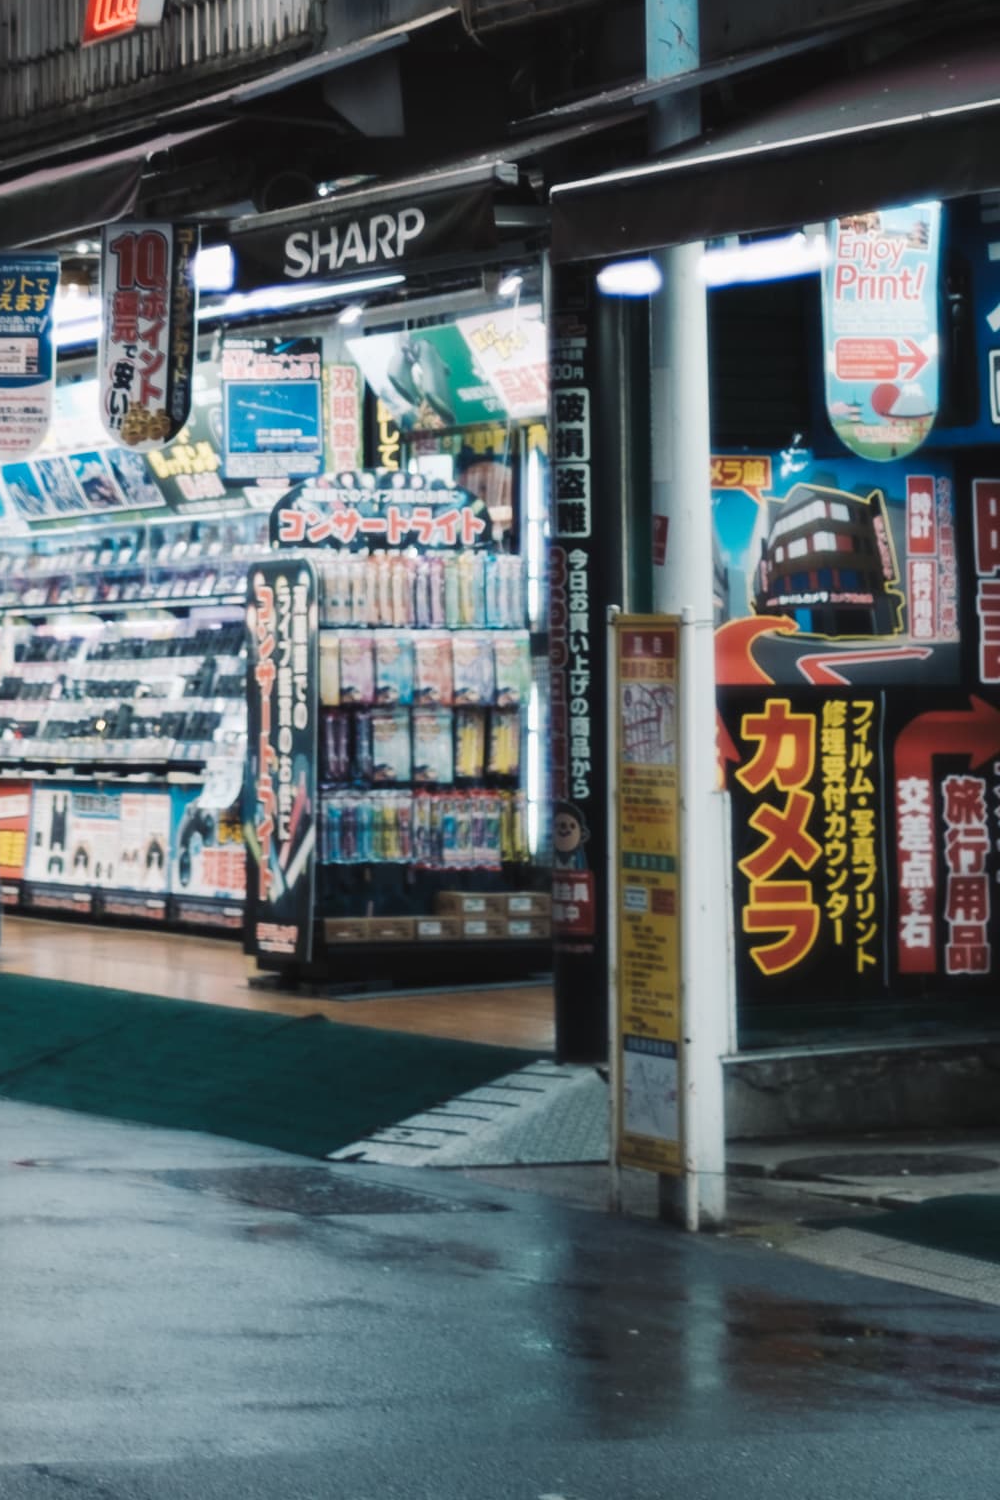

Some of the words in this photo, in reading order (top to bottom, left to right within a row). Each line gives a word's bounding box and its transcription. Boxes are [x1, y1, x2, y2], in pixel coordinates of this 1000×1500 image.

[284, 206, 426, 278] SHARP
[835, 263, 926, 300] Print!
[837, 229, 905, 269] Enjoy
[278, 507, 485, 545] コンサートライト
[567, 547, 590, 800] 今日お買い上げの商品から
[735, 698, 823, 975] カメラ
[821, 700, 849, 945] 修理受付カウンター
[849, 700, 877, 973] フィルム・写真プリント
[897, 776, 933, 948] 交差点を右
